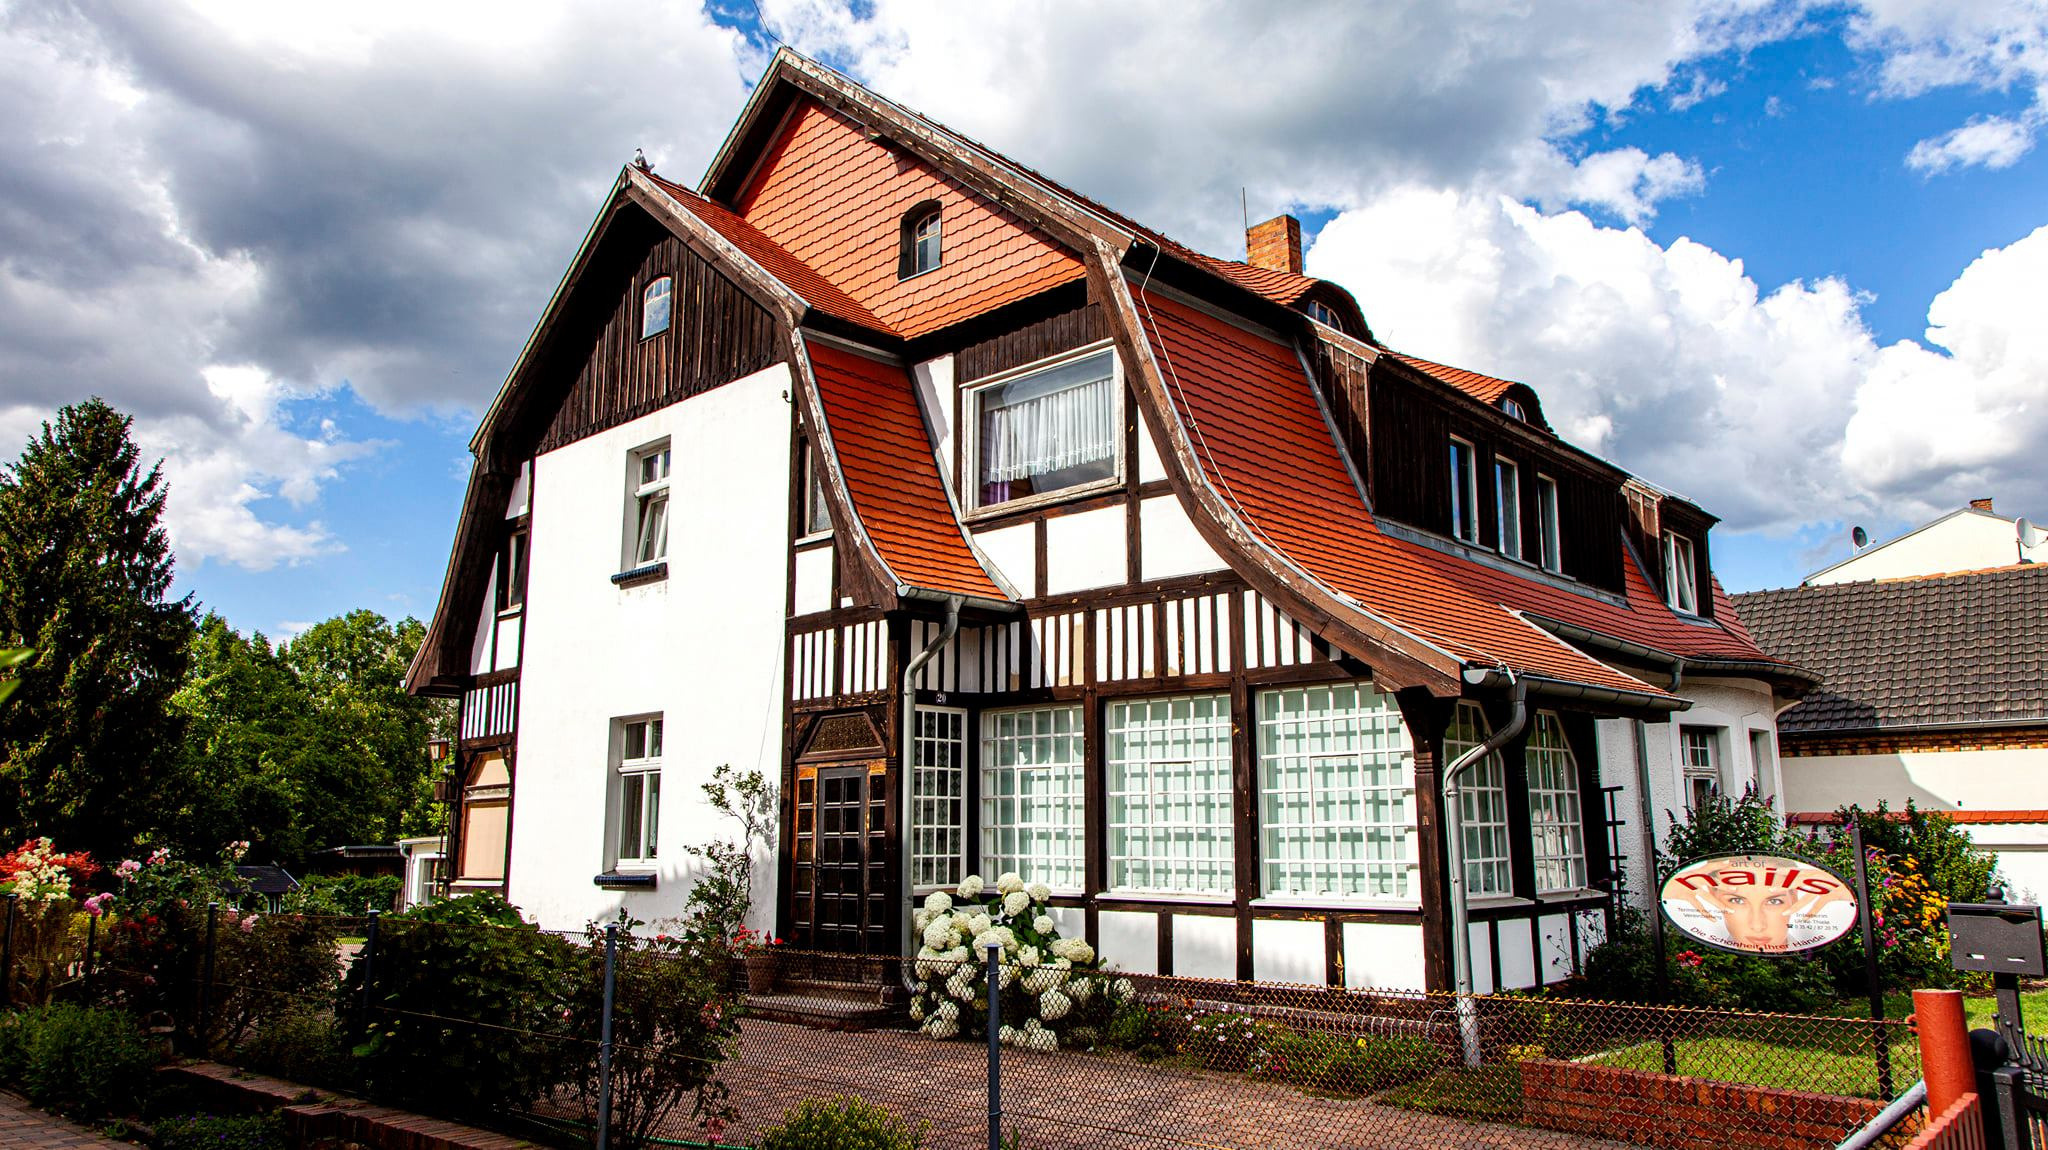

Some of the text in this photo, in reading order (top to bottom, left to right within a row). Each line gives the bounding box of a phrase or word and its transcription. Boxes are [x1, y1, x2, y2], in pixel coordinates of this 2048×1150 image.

[1731, 860, 1766, 868] art of
[1675, 868, 1840, 895] nails
[1690, 927, 1706, 937] Die
